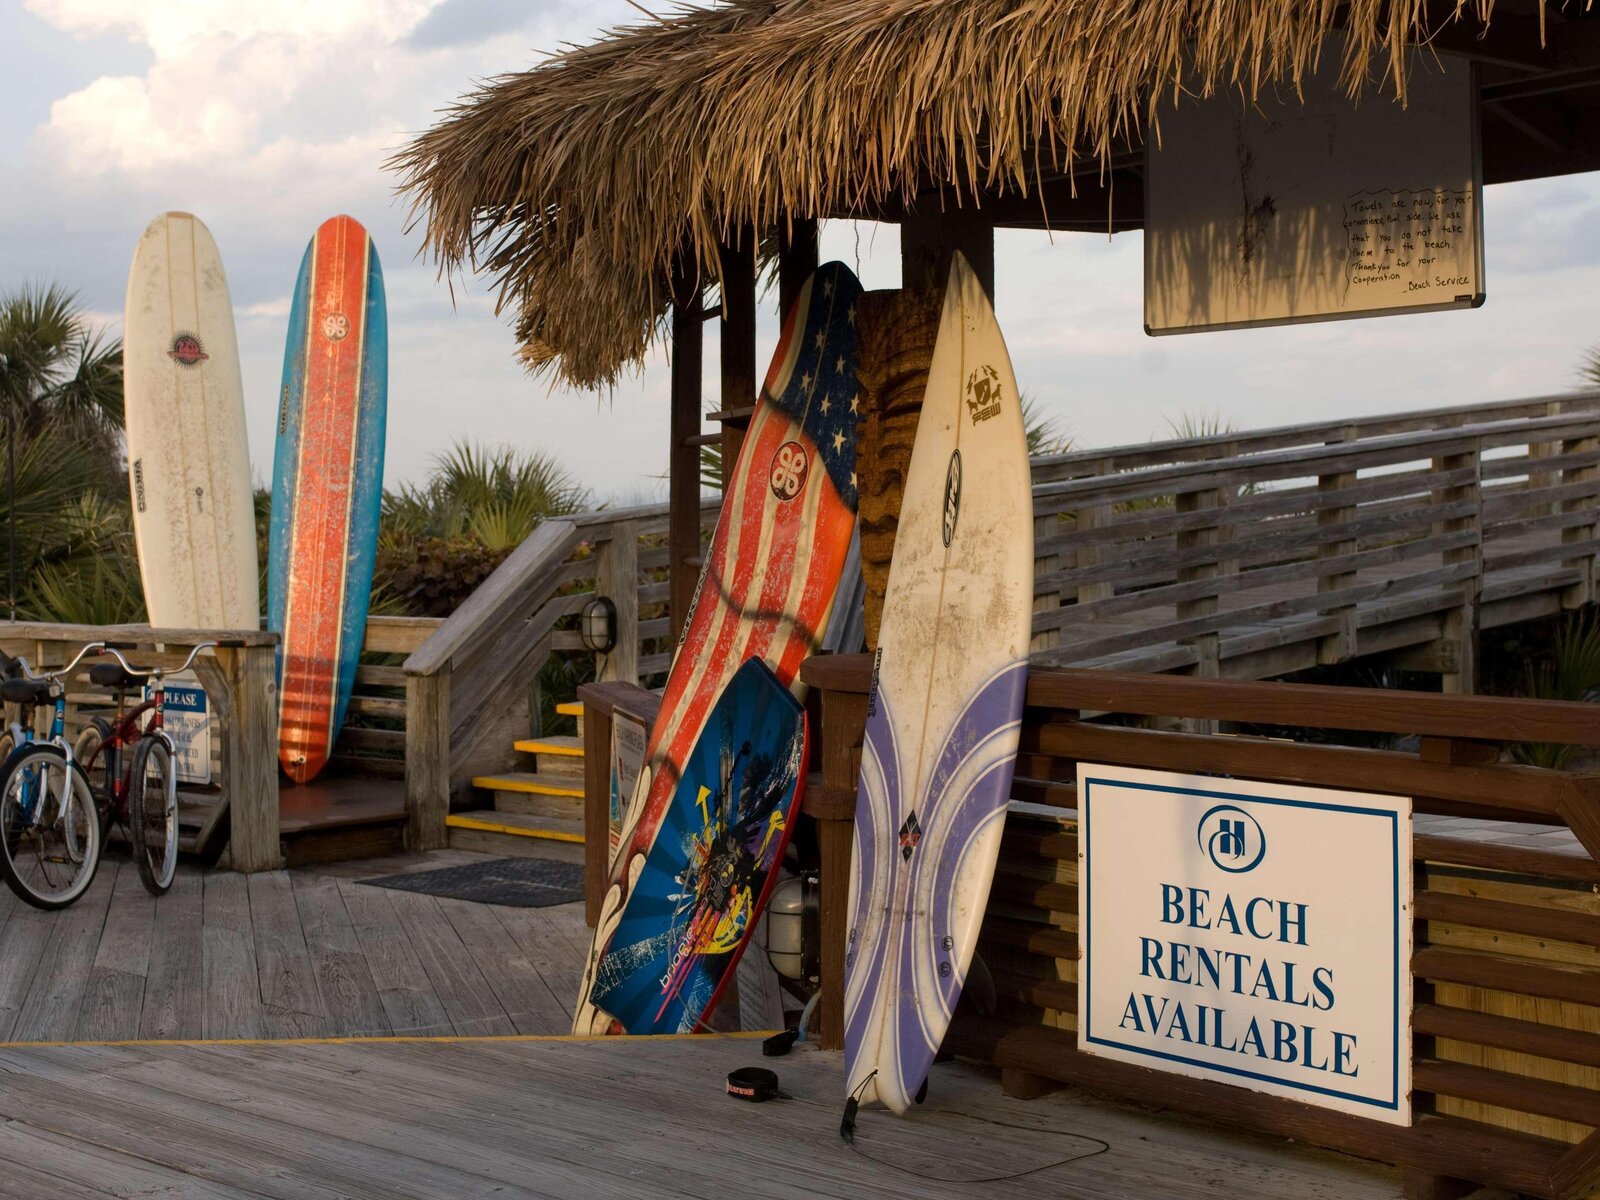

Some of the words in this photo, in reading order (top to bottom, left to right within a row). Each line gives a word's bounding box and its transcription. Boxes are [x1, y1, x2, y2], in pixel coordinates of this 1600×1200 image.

[1351, 199, 1383, 213] Towels
[1391, 200, 1406, 209] are
[1436, 195, 1449, 205] for
[1454, 195, 1472, 208] your
[1428, 211, 1440, 221] We
[1446, 211, 1461, 220] ask
[1351, 231, 1371, 242] that
[1378, 233, 1391, 245] you
[1401, 231, 1411, 240] do
[1416, 226, 1432, 237] not
[1441, 225, 1464, 233] take
[1384, 246, 1395, 254] to
[1402, 242, 1414, 252] the
[1396, 257, 1410, 268] for
[1418, 257, 1436, 268] your
[1435, 274, 1470, 287] Service
[164, 691, 197, 706] PLEASE
[1160, 883, 1310, 946] BEACH
[1138, 936, 1336, 1011] RENTALS
[1118, 991, 1359, 1078] AVAILABLE
